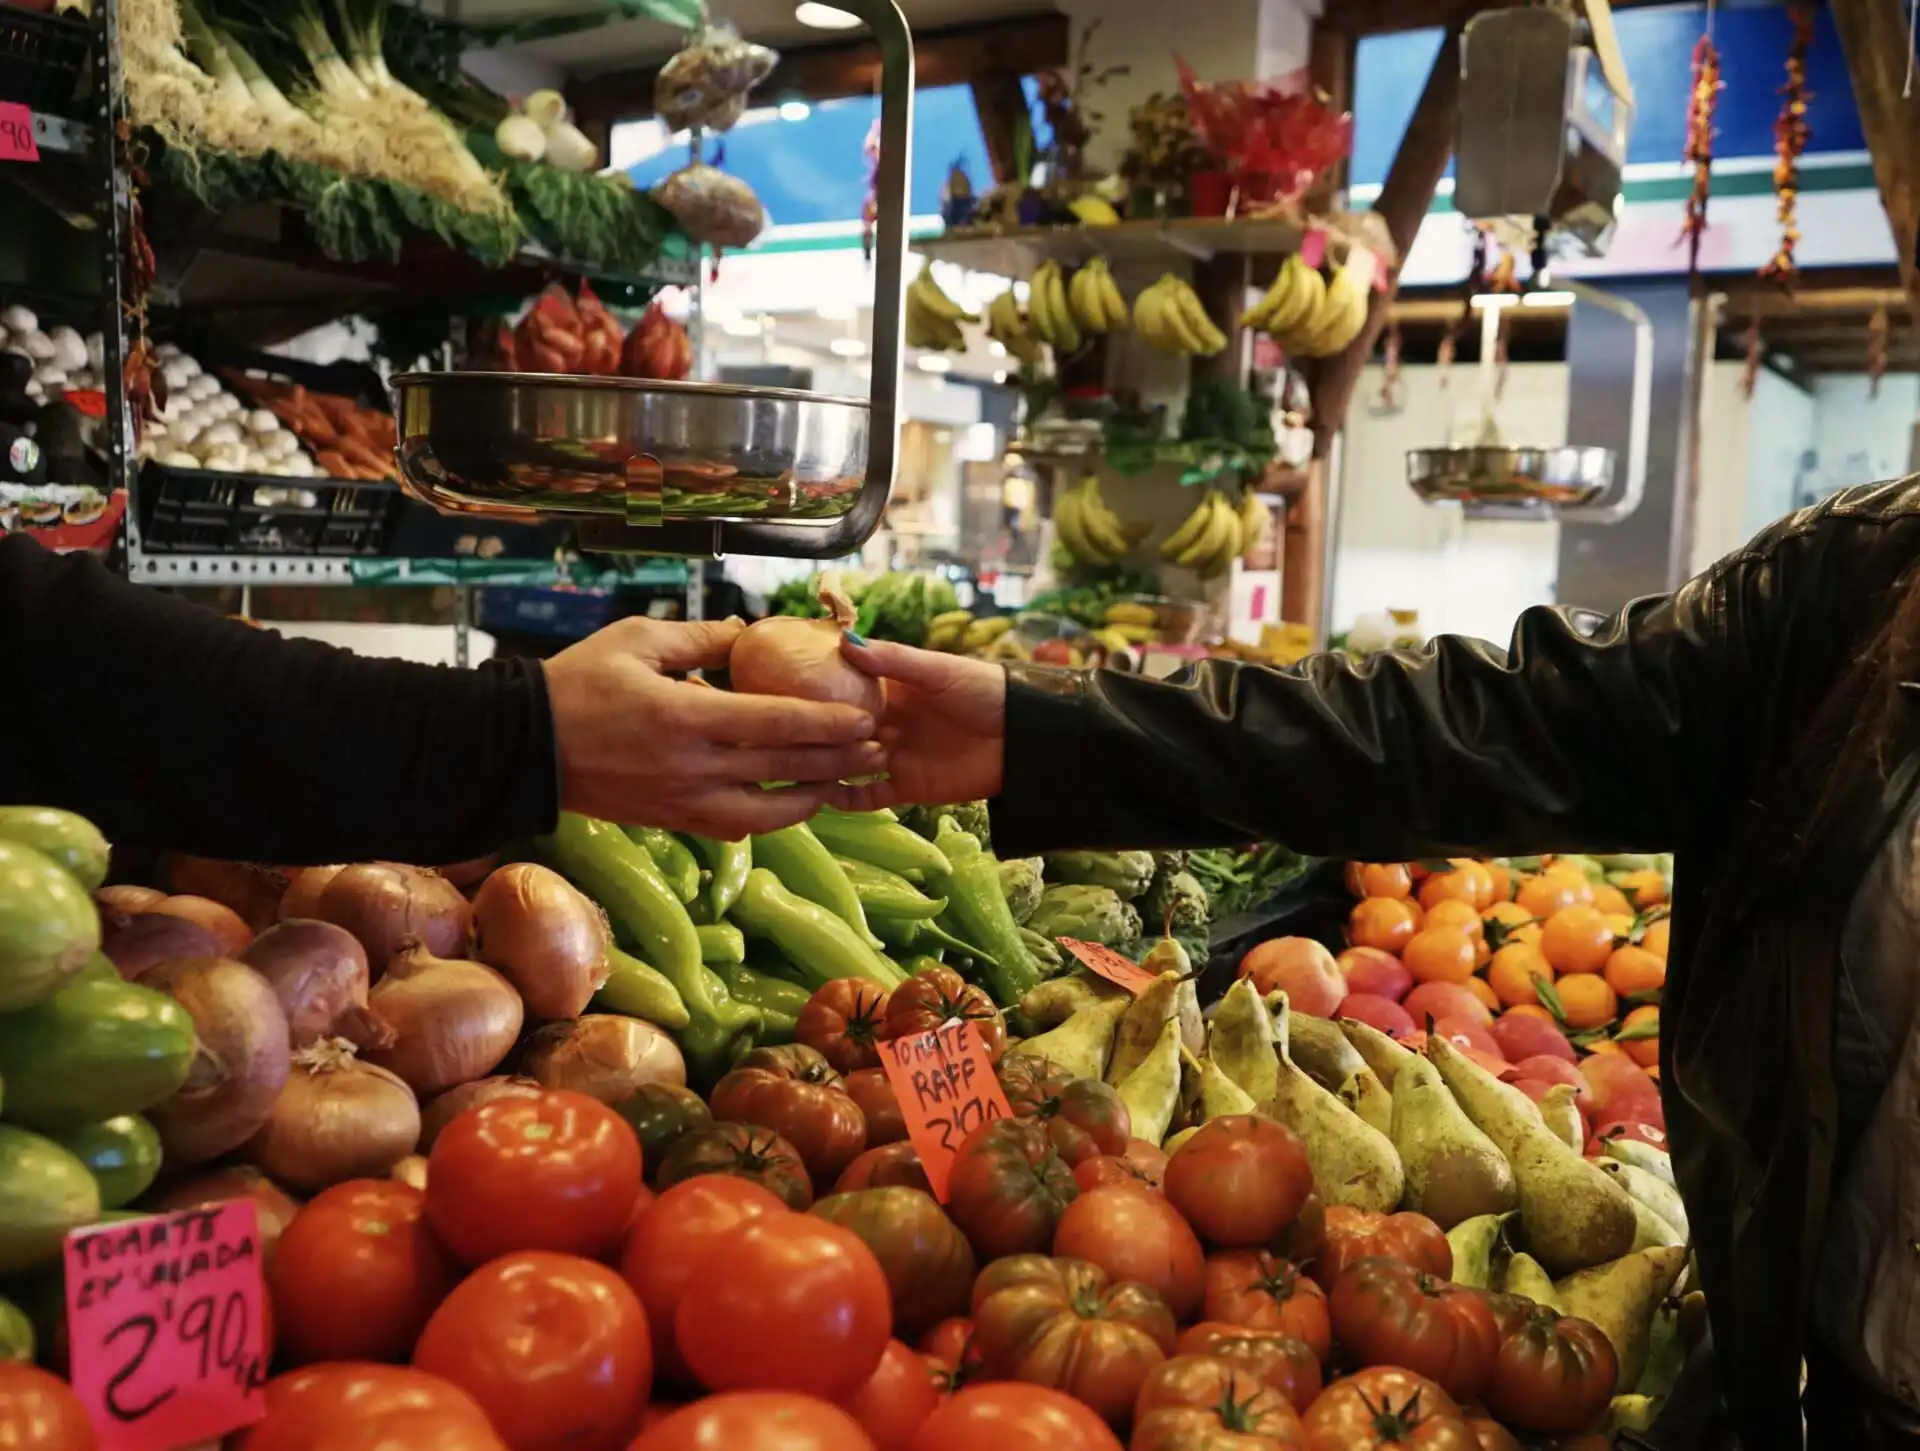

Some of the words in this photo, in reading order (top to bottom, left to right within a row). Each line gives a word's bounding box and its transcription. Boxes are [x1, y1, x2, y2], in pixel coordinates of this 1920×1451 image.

[888, 1024, 968, 1067] TOMATE
[912, 1059, 975, 1111] RAFF
[73, 1208, 223, 1268] TOMATE
